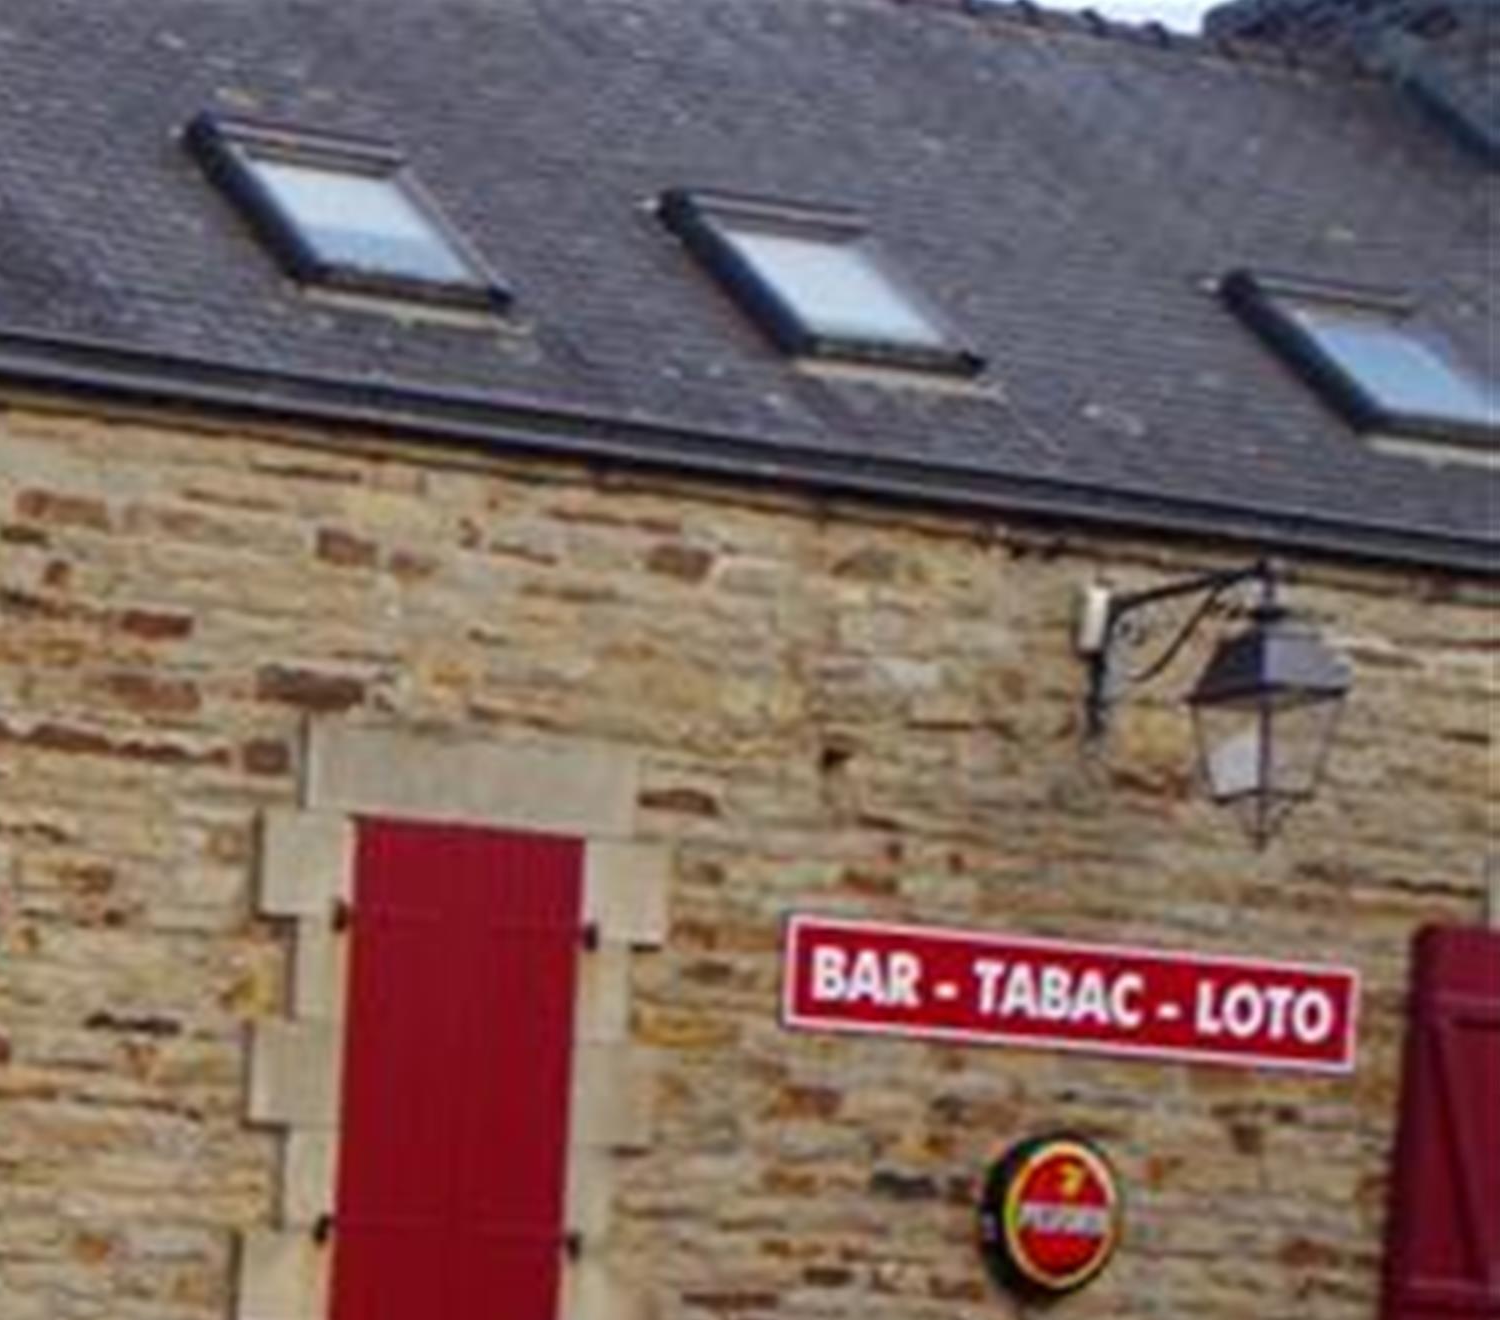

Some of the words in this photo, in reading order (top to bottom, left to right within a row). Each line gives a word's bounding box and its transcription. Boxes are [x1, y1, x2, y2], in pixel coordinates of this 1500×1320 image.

[811, 946, 921, 1007] BAR
[974, 961, 1145, 1027] TABAC
[1196, 981, 1333, 1043] LOTO
